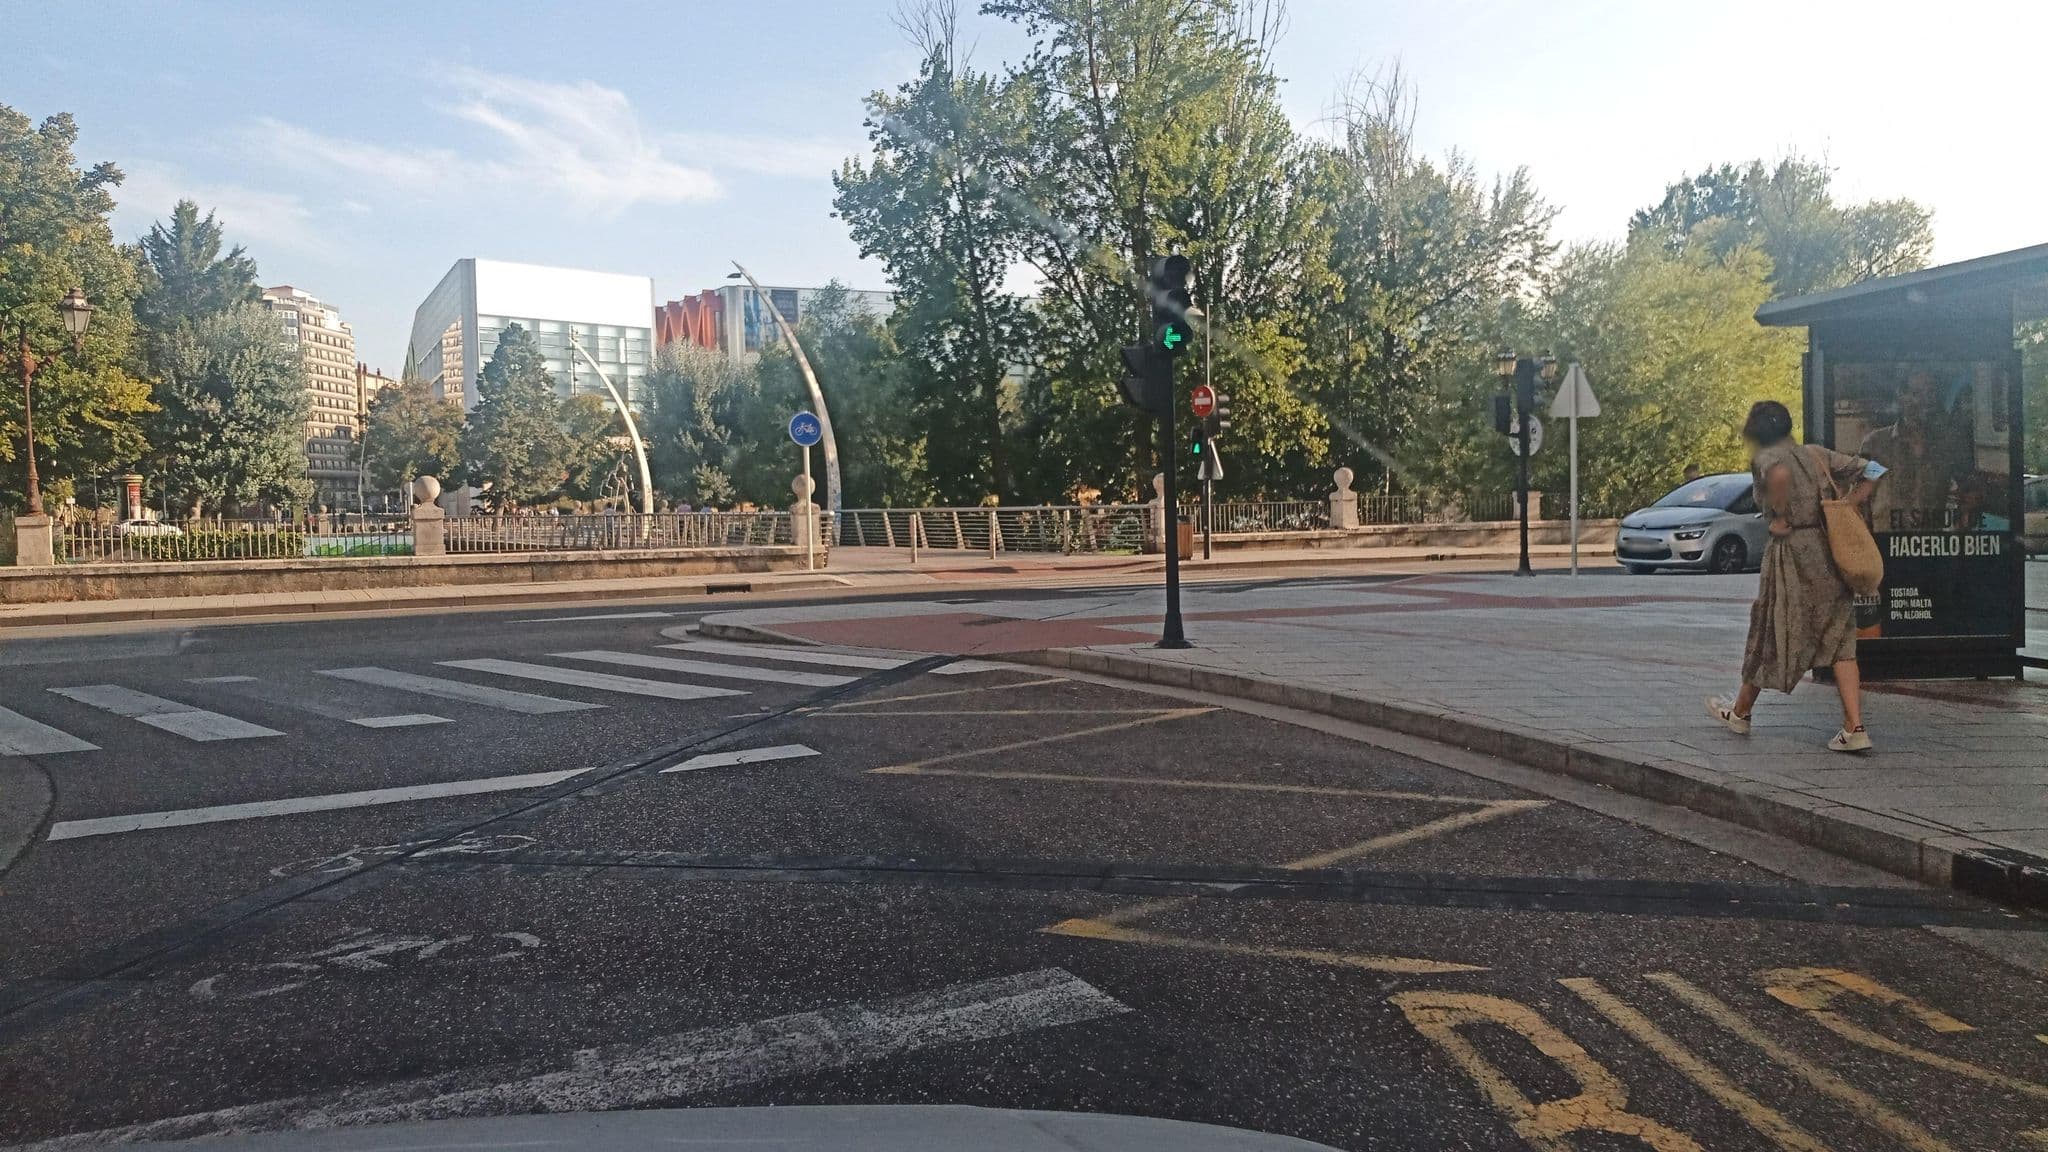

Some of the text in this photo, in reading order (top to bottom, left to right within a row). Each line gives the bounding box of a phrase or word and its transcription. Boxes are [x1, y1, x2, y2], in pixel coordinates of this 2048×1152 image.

[1890, 535, 2000, 557] HACERLO BIEN
[1891, 588, 1919, 597] TOSTADA
[1891, 598, 1909, 609] 100%
[1910, 598, 1932, 609] MALTA
[1891, 610, 1933, 620] 0% ALCOHOL
